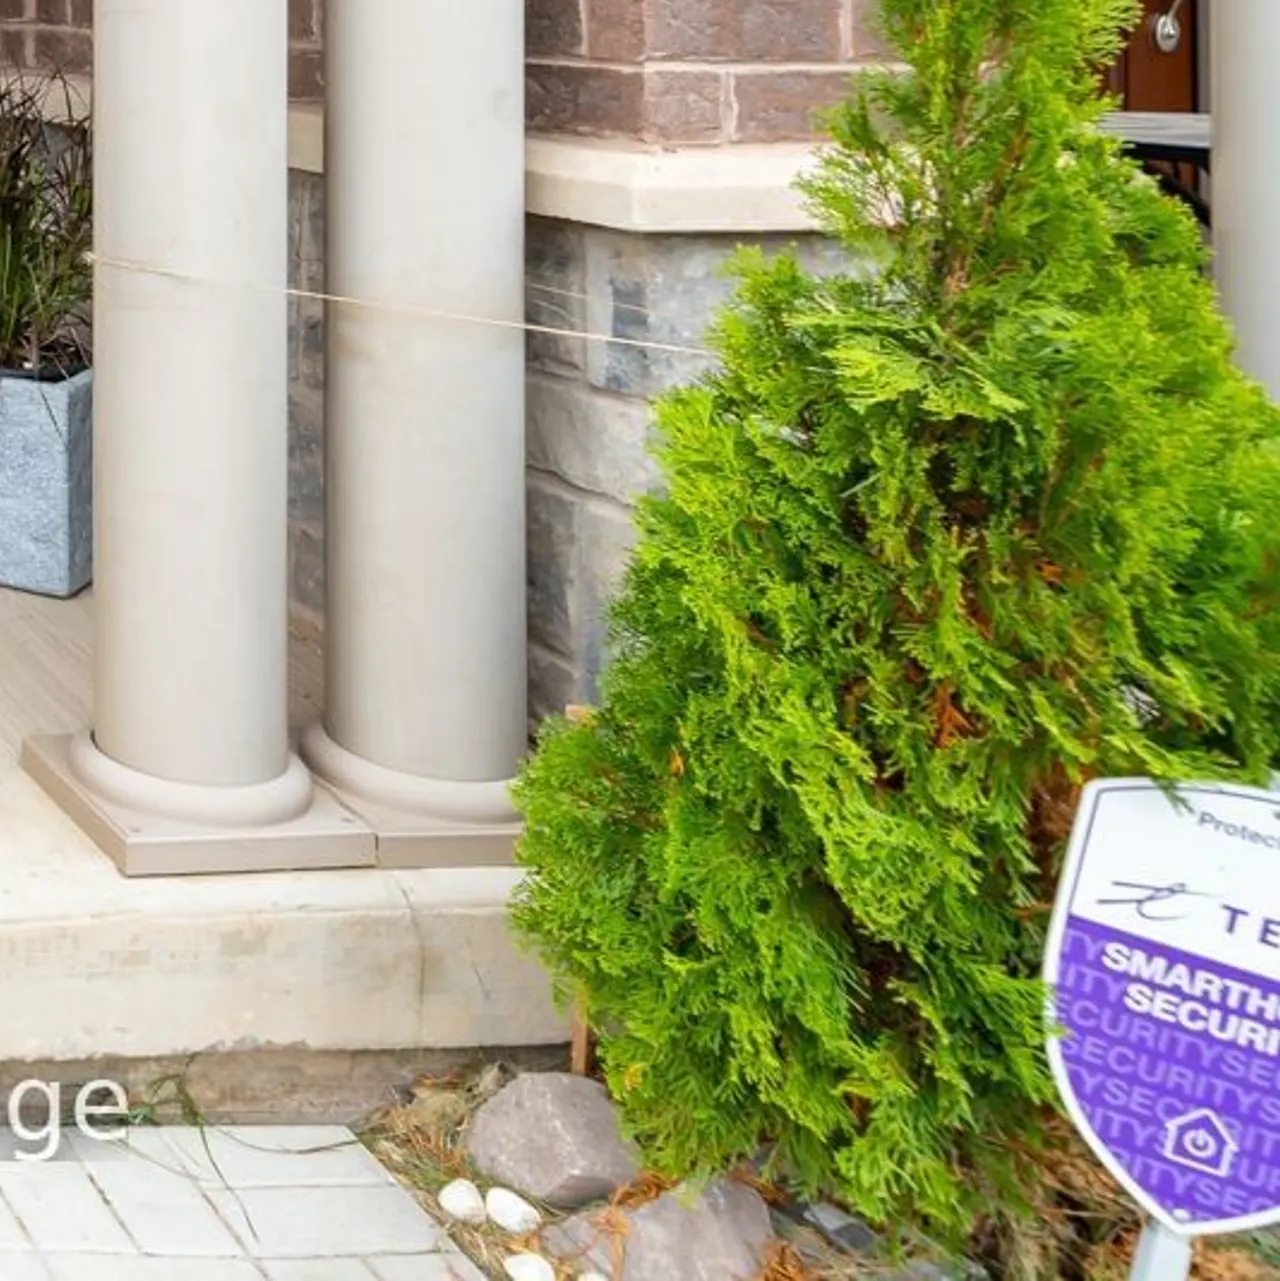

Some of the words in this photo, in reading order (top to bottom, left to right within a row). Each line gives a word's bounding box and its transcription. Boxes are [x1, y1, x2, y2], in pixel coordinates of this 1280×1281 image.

[1222, 904, 1280, 949] TE
[1101, 941, 1280, 1022] SMARTH
[1124, 983, 1280, 1057] SECURI
